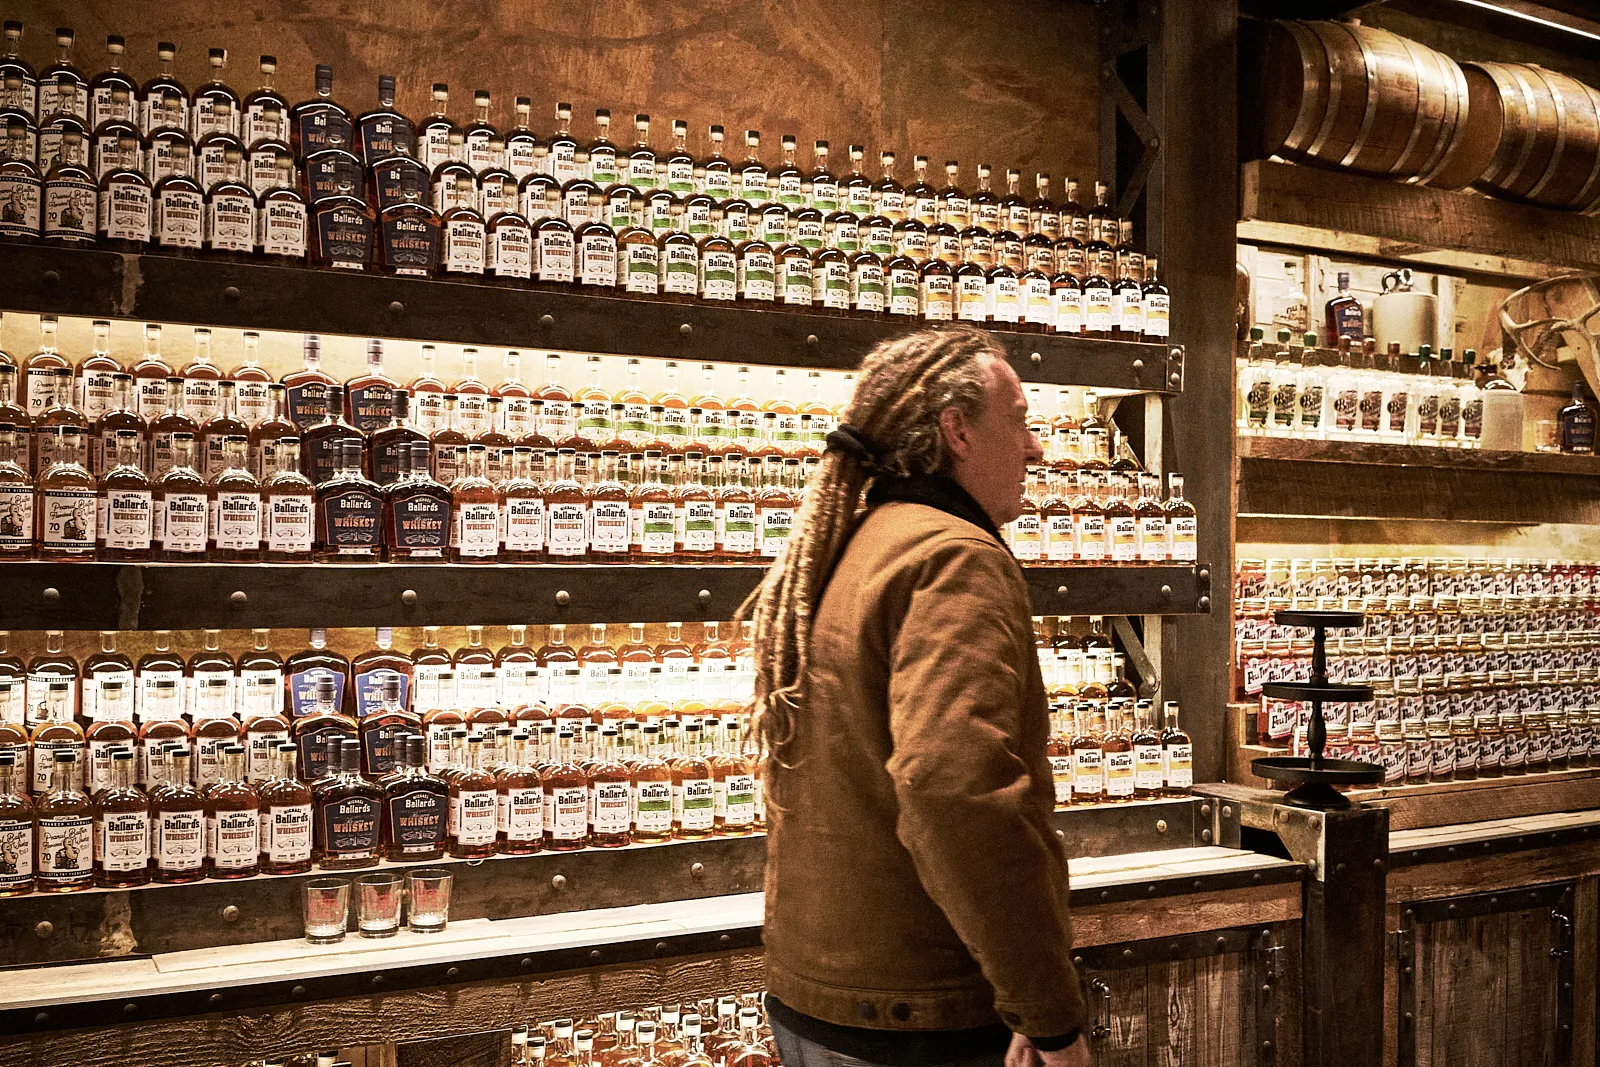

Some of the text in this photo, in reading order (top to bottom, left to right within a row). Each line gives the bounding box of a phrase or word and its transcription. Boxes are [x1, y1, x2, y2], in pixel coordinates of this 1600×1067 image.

[115, 203, 147, 214] WHISKEY
[167, 211, 199, 221] WHISKEY
[218, 215, 249, 225] WHISKEY
[271, 220, 302, 229] WHISKEY
[328, 231, 367, 242] WHISKEY
[391, 239, 430, 249] WHISKEY
[453, 240, 481, 248] WHISKEY
[502, 245, 528, 253] WHISKEY
[88, 378, 112, 387] Ballar
[142, 386, 166, 395] Ballar
[302, 389, 326, 398] Ballard
[171, 515, 203, 523] WHISKEY
[223, 514, 255, 522] WHISKEY
[275, 516, 307, 524] WHISKEY
[334, 518, 375, 527] WHISKEY
[403, 520, 442, 530] WHISKEY
[37, 773, 47, 781] 70
[466, 810, 493, 818] WHISKEY
[515, 807, 540, 815] WHISKEY
[560, 806, 585, 815] WHISKEY
[276, 813, 308, 824] Ballard's
[400, 815, 439, 826] WHISKEY
[109, 819, 144, 831] Ballard's
[164, 819, 200, 830] Ballard's
[221, 818, 255, 829] Ballard's
[333, 821, 374, 833] WHISKEY
[277, 826, 307, 835] WHISKEY
[109, 834, 143, 842] WHISKEY
[165, 832, 198, 840] WHISKEY
[221, 831, 253, 840] WHISKEY
[42, 853, 51, 861] 70
